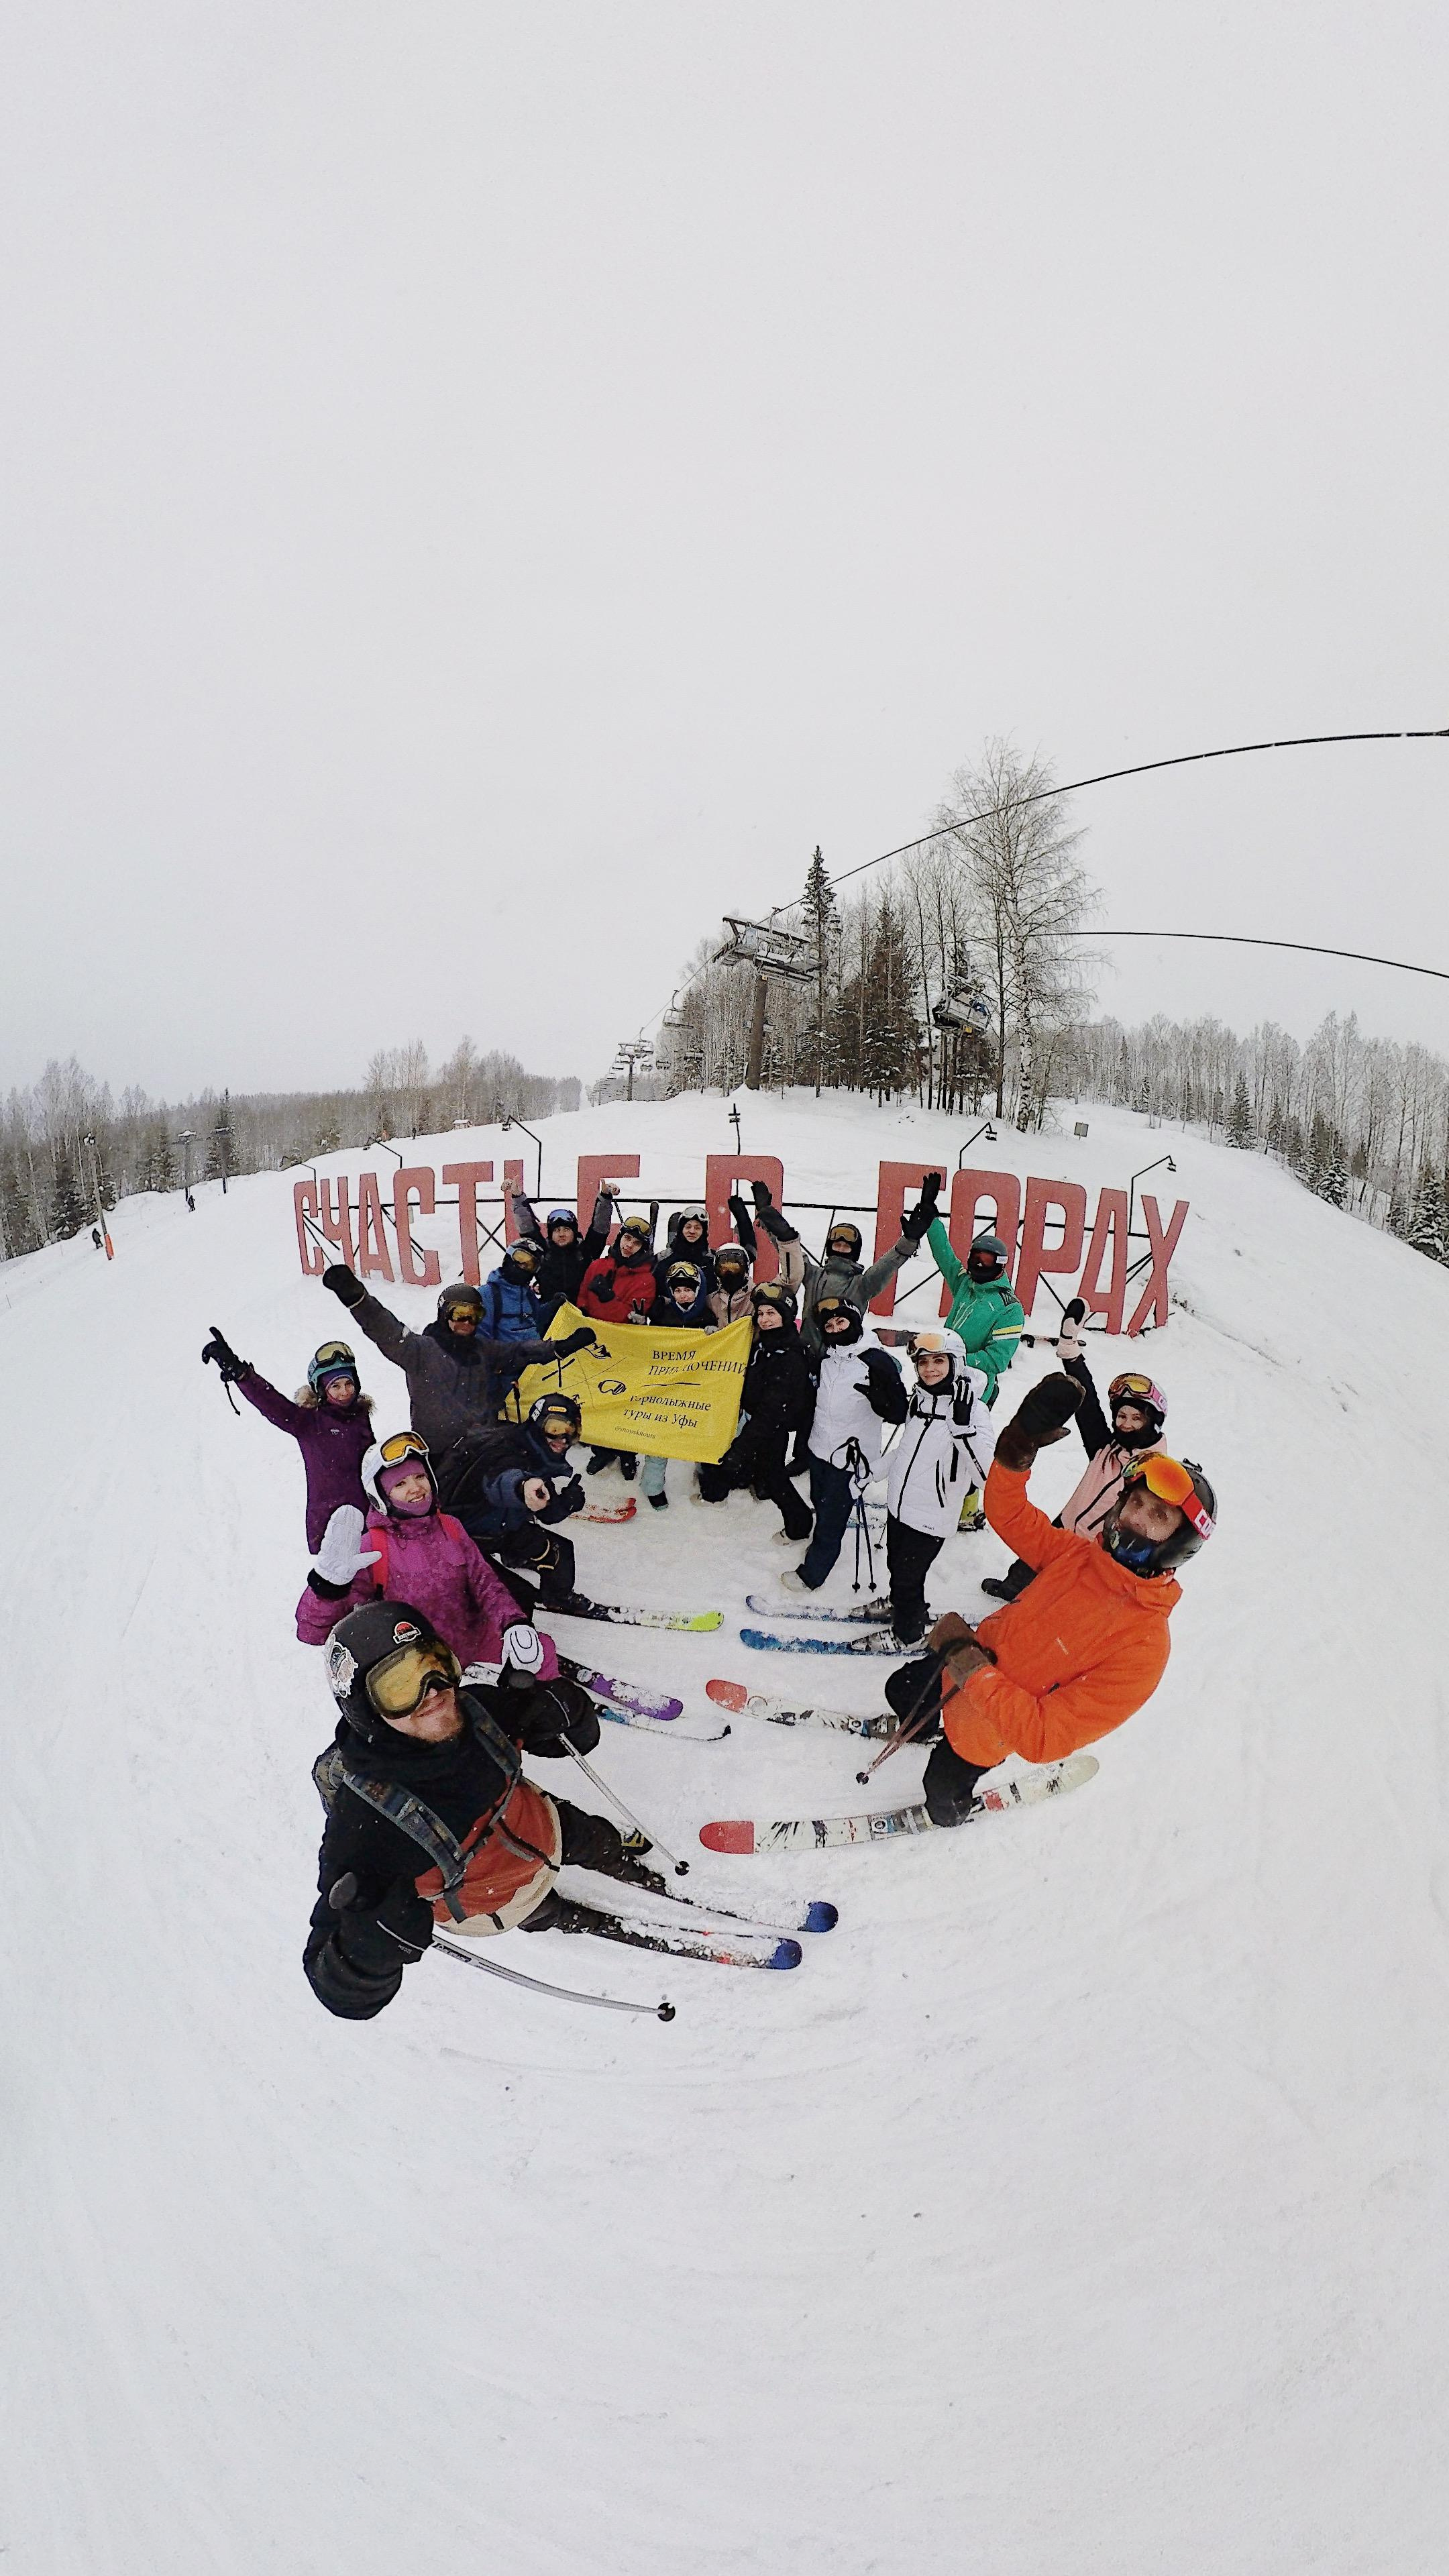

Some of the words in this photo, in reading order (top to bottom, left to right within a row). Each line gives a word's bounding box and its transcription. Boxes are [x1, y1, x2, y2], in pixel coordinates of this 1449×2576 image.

[706, 1155, 784, 1285] В
[868, 1161, 1190, 1338] ГОРАХ
[653, 1350, 696, 1361] ВРЕМЯ
[624, 1409, 652, 1421] туры
[654, 1413, 668, 1423] из
[672, 1413, 698, 1429] Уфы
